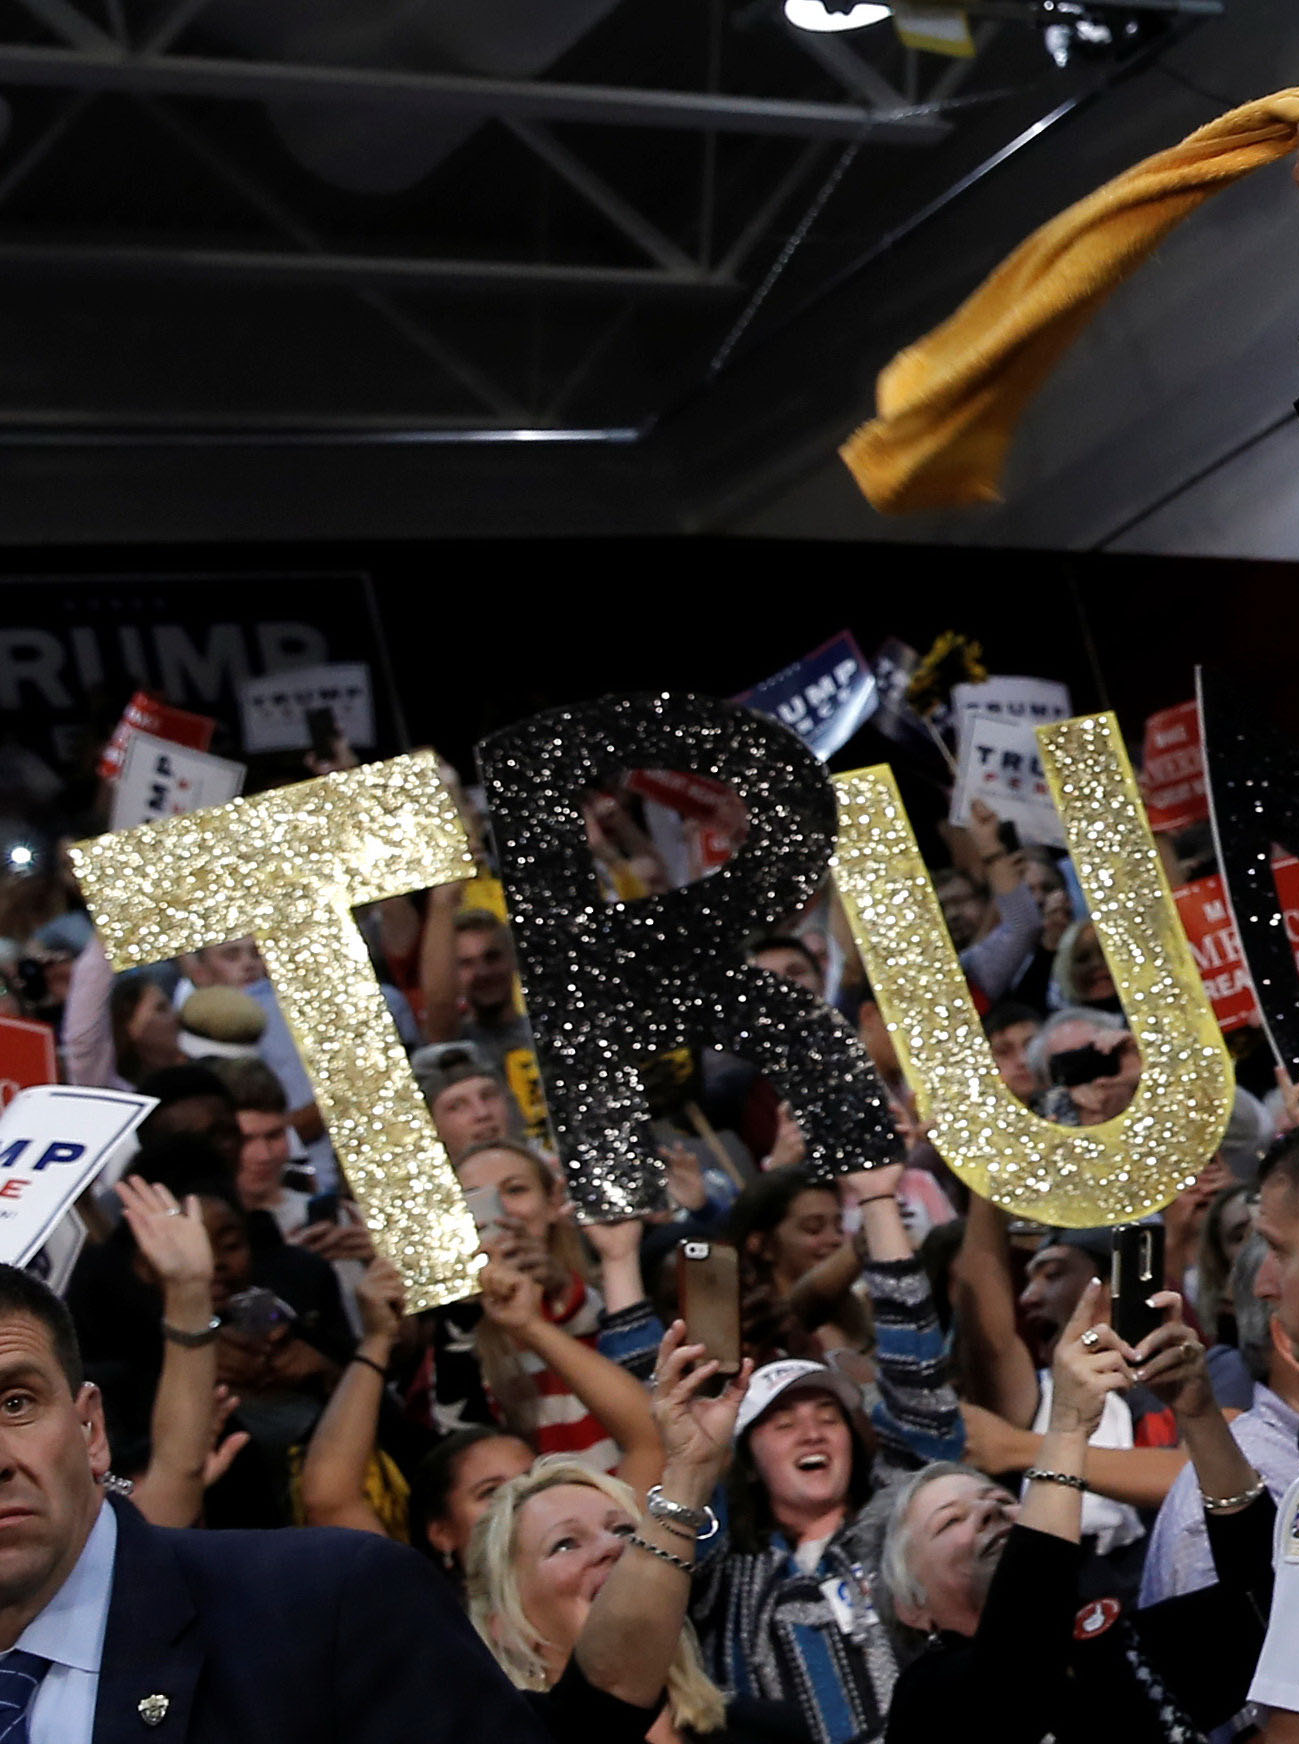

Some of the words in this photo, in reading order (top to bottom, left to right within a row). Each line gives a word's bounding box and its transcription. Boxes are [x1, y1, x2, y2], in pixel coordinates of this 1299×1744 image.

[0, 619, 328, 712] RUMP
[777, 658, 857, 724] UMP
[976, 745, 1044, 777] TRU
